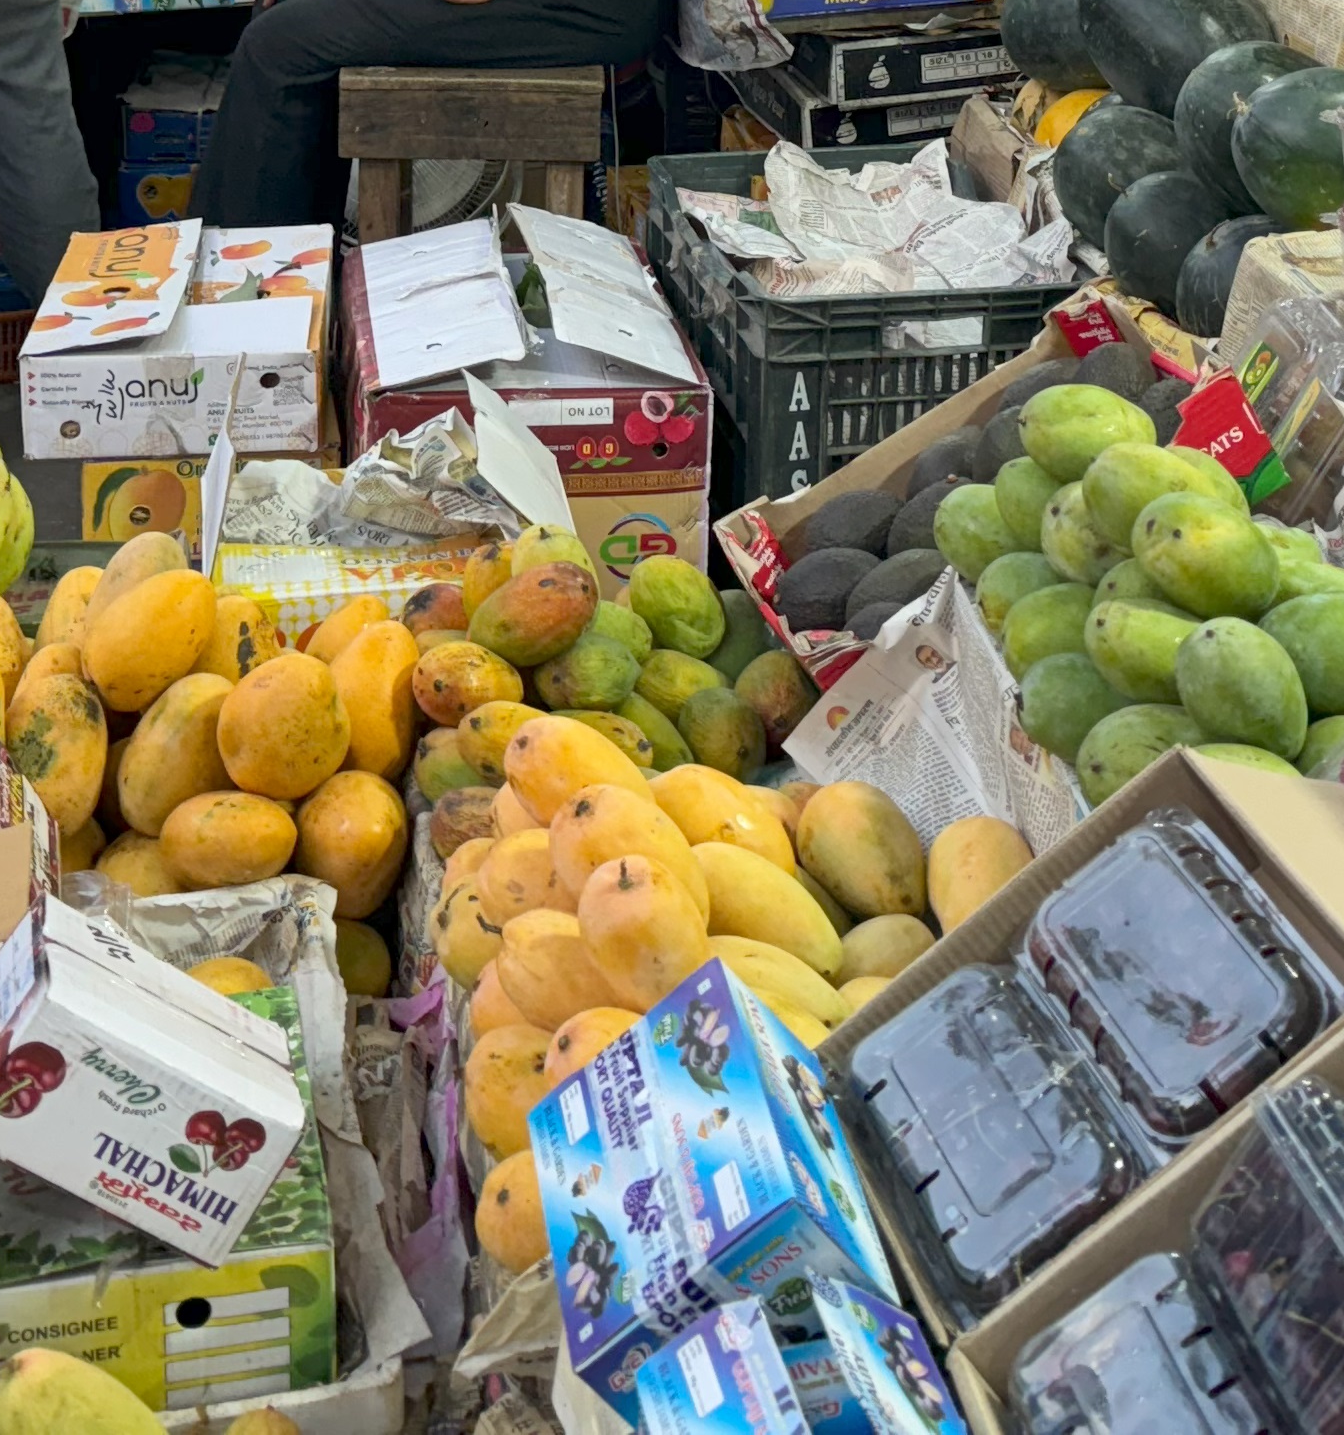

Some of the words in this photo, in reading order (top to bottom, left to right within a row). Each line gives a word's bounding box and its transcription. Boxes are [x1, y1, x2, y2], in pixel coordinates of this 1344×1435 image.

[982, 51, 993, 60] 18
[90, 233, 149, 279] anuj
[1078, 328, 1111, 339] westfalia
[125, 369, 199, 404] anuj
[129, 400, 154, 408] FRUITS
[166, 399, 188, 407] NUTS
[587, 406, 611, 416] LOT
[80, 1048, 162, 1106] Cherry
[97, 1089, 123, 1115] Fresh
[122, 1101, 167, 1120] Orchard
[601, 1086, 624, 1150] QUALITY
[615, 1082, 639, 1151] Supplier
[93, 1131, 240, 1226] HIMACHAL
[94, 1170, 204, 1235] देवभूमि
[750, 1242, 803, 1285] SONS
[7, 1316, 120, 1345] CONSIGNEE
[80, 1343, 123, 1364] NER
